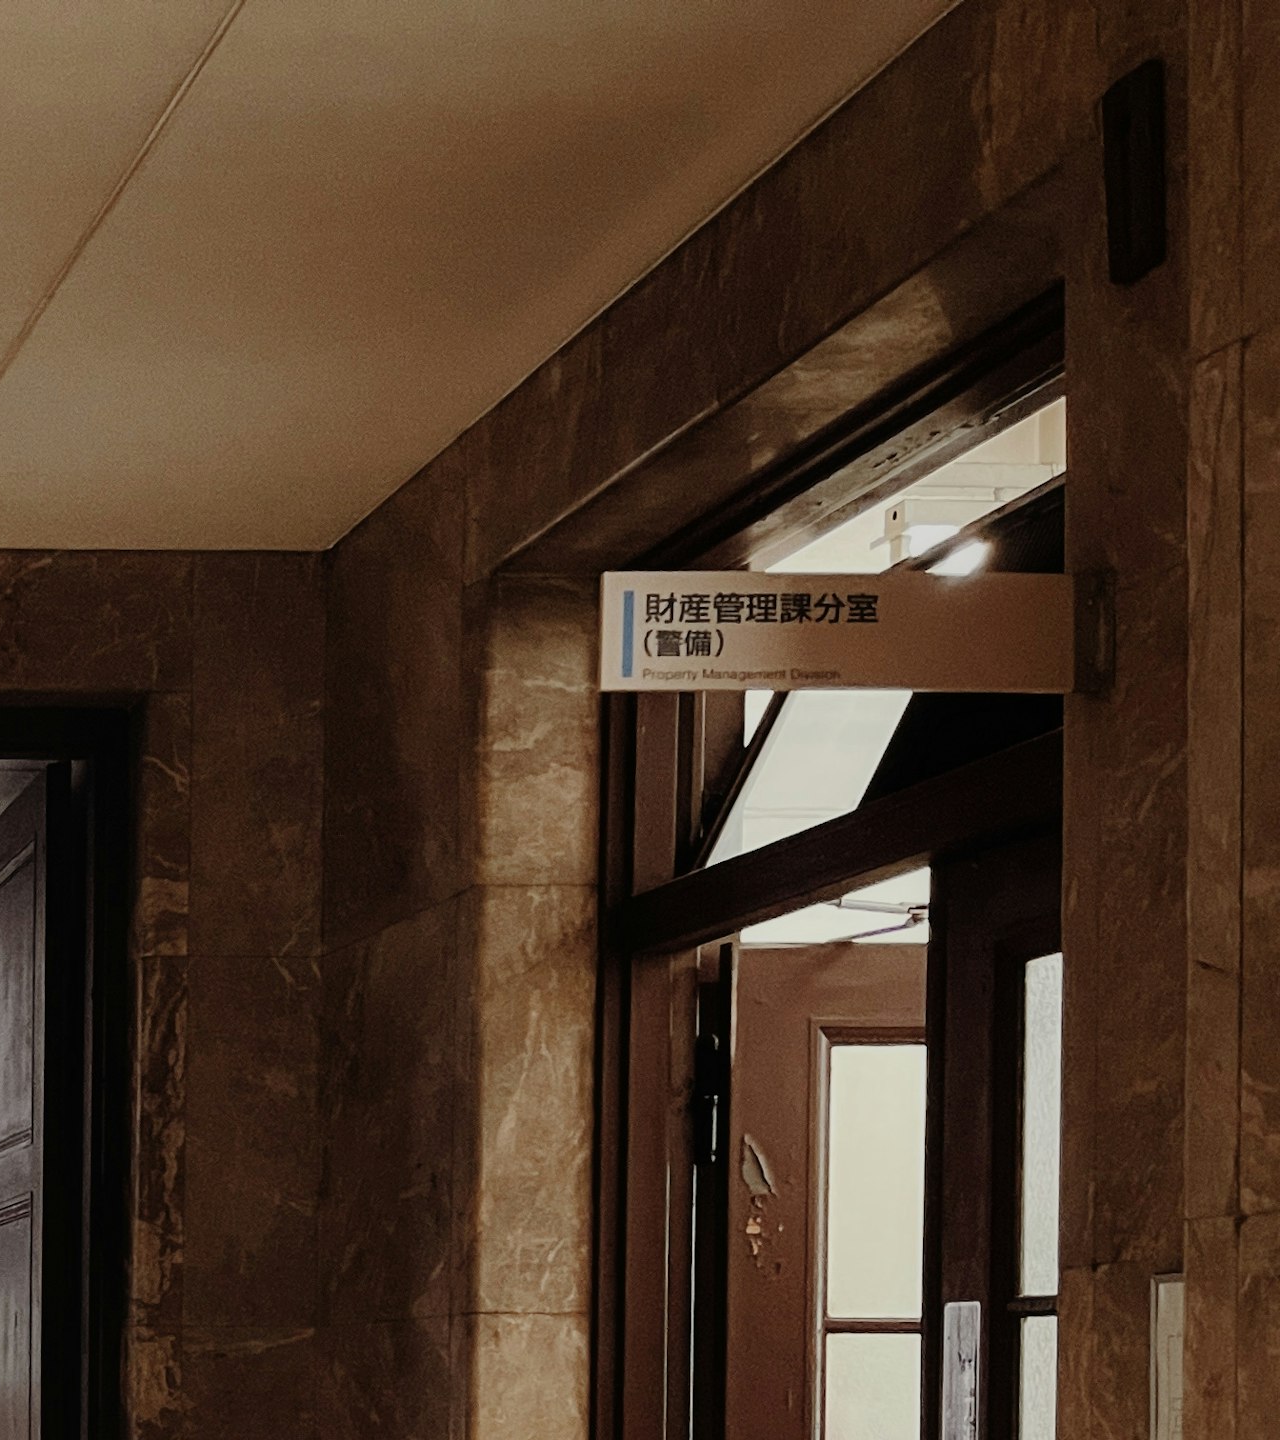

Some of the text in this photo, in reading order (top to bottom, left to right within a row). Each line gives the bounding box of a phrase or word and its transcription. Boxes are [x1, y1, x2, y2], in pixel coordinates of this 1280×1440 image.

[645, 592, 879, 625] 財産管理課分室
[642, 667, 841, 682] Property Management Division
